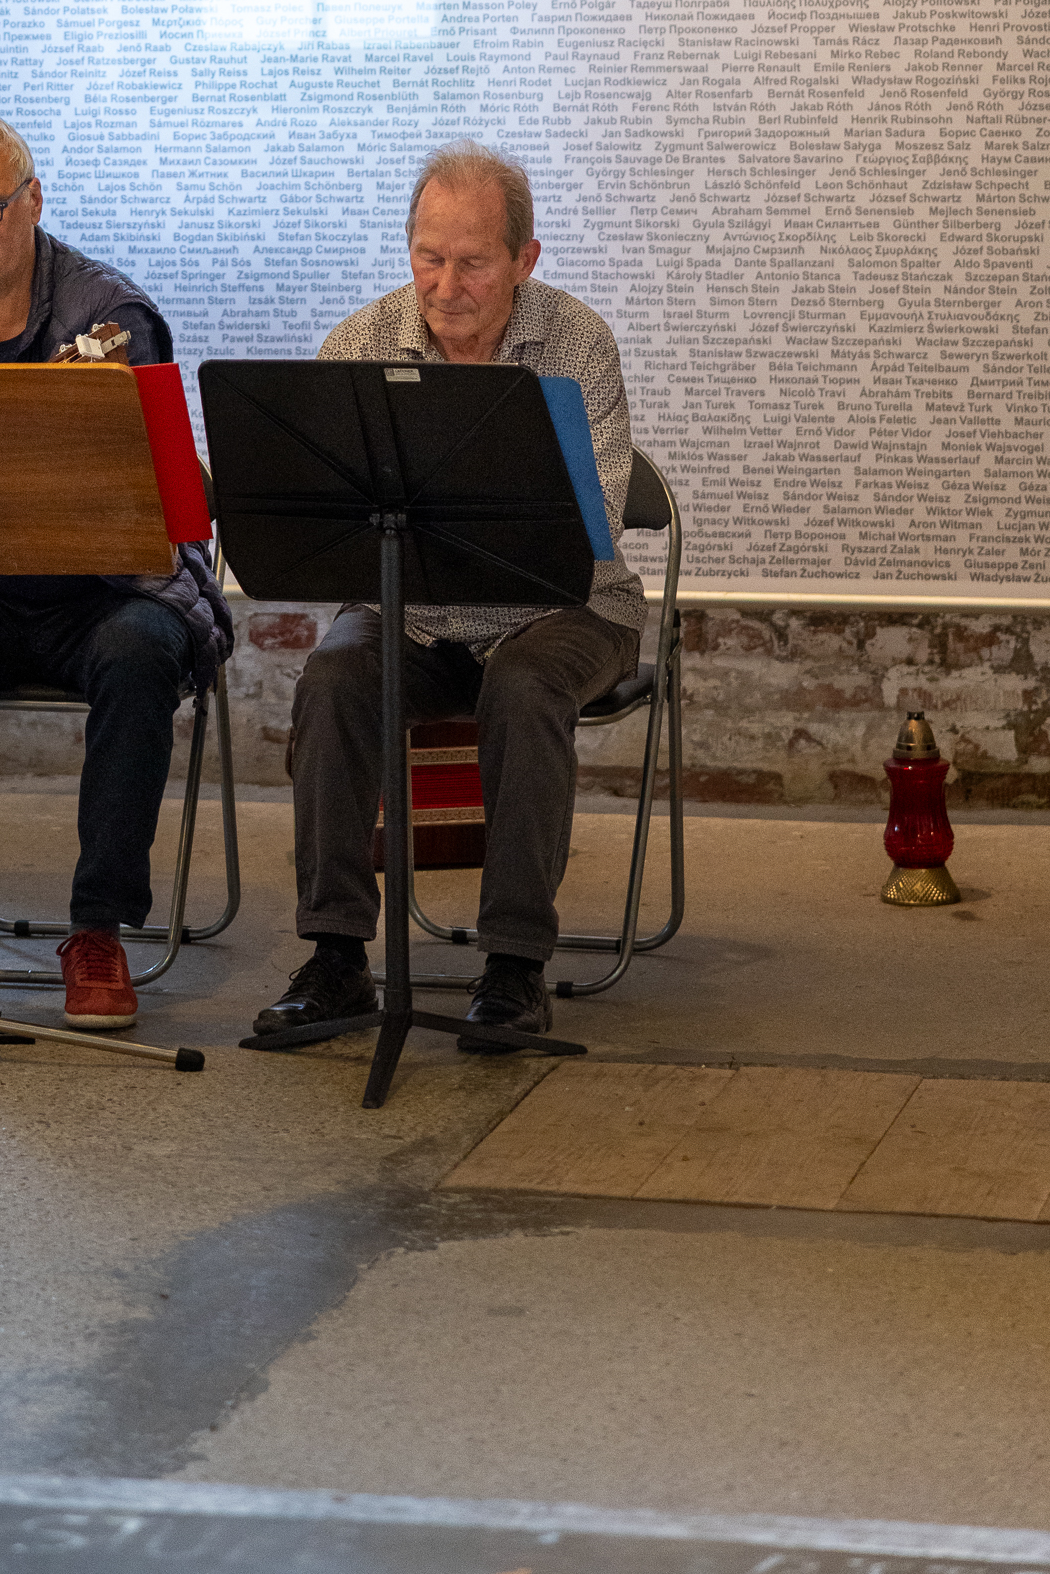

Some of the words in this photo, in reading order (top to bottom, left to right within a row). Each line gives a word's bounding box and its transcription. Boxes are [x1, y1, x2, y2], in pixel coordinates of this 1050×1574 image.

[280, 193, 313, 204] Gábor
[315, 193, 365, 204] Schwartz
[130, 207, 167, 218] Henryk
[170, 205, 215, 217] Sekulski
[684, 387, 722, 398] Marcel
[724, 387, 766, 398] Travers
[837, 401, 871, 411] Bruno
[874, 401, 913, 412] Turella
[934, 544, 975, 557] Henryk
[977, 546, 1007, 557] Zaler
[762, 568, 799, 579] Stefan
